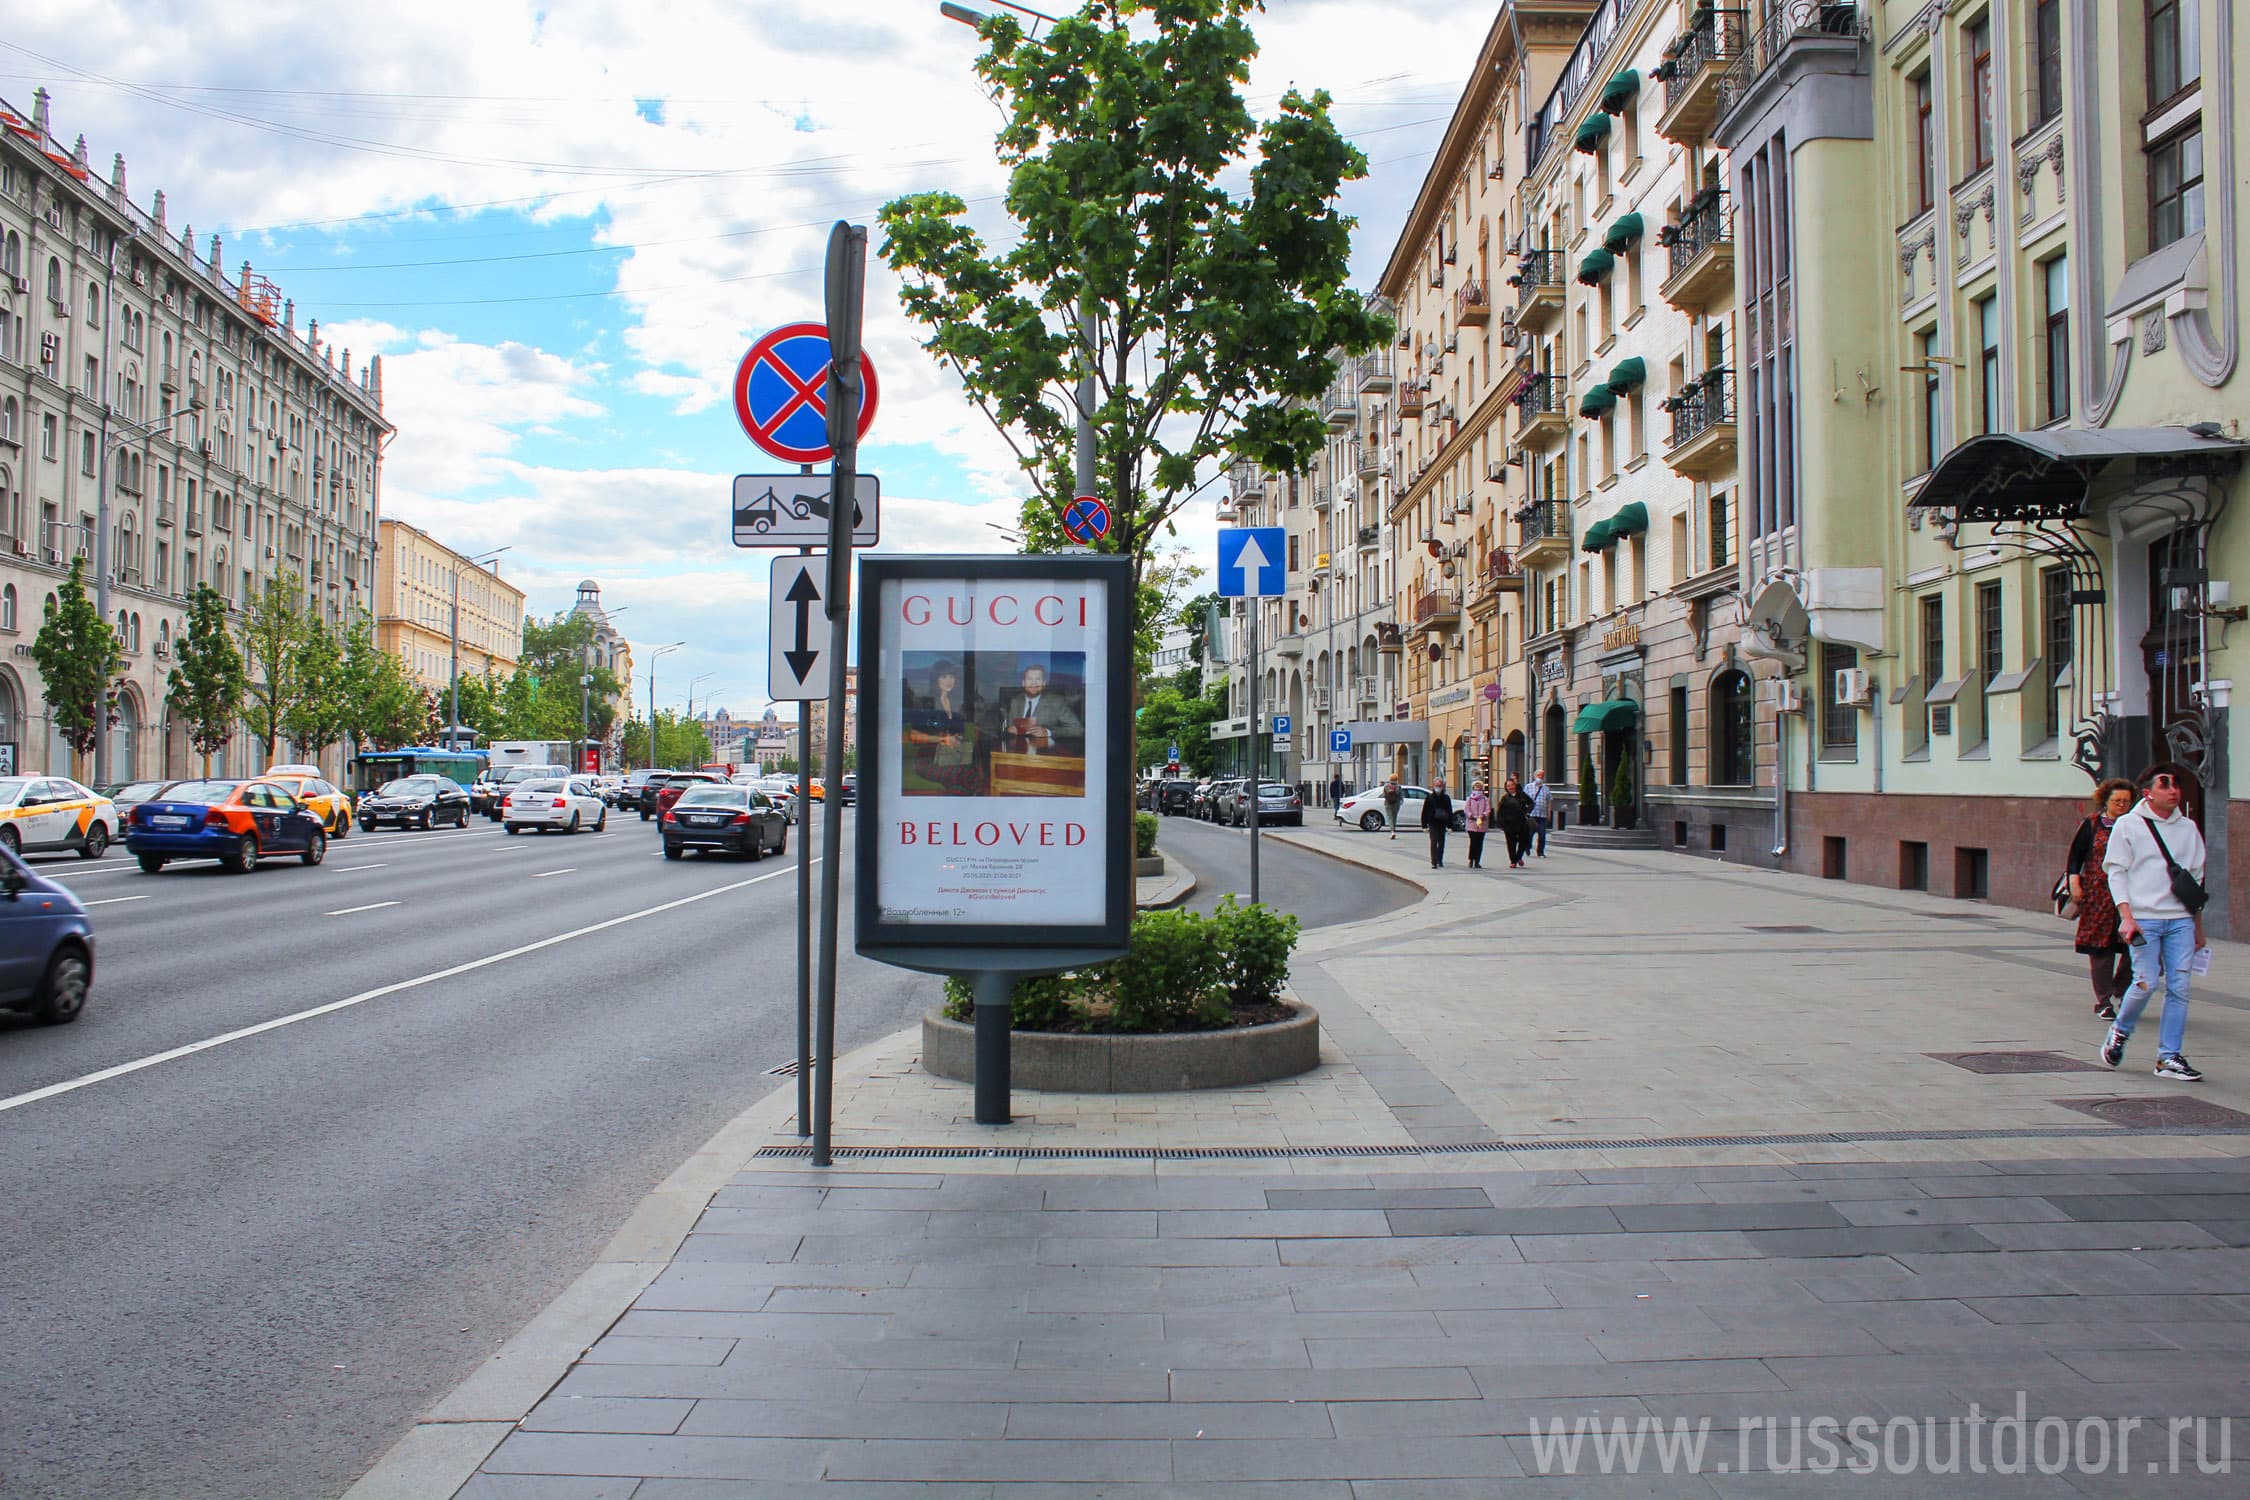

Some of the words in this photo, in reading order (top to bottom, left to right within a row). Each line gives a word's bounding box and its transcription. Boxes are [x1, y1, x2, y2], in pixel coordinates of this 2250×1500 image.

[902, 595, 1086, 627] GUCCI
[1336, 733, 1347, 749] P
[953, 908, 966, 916] 12+
